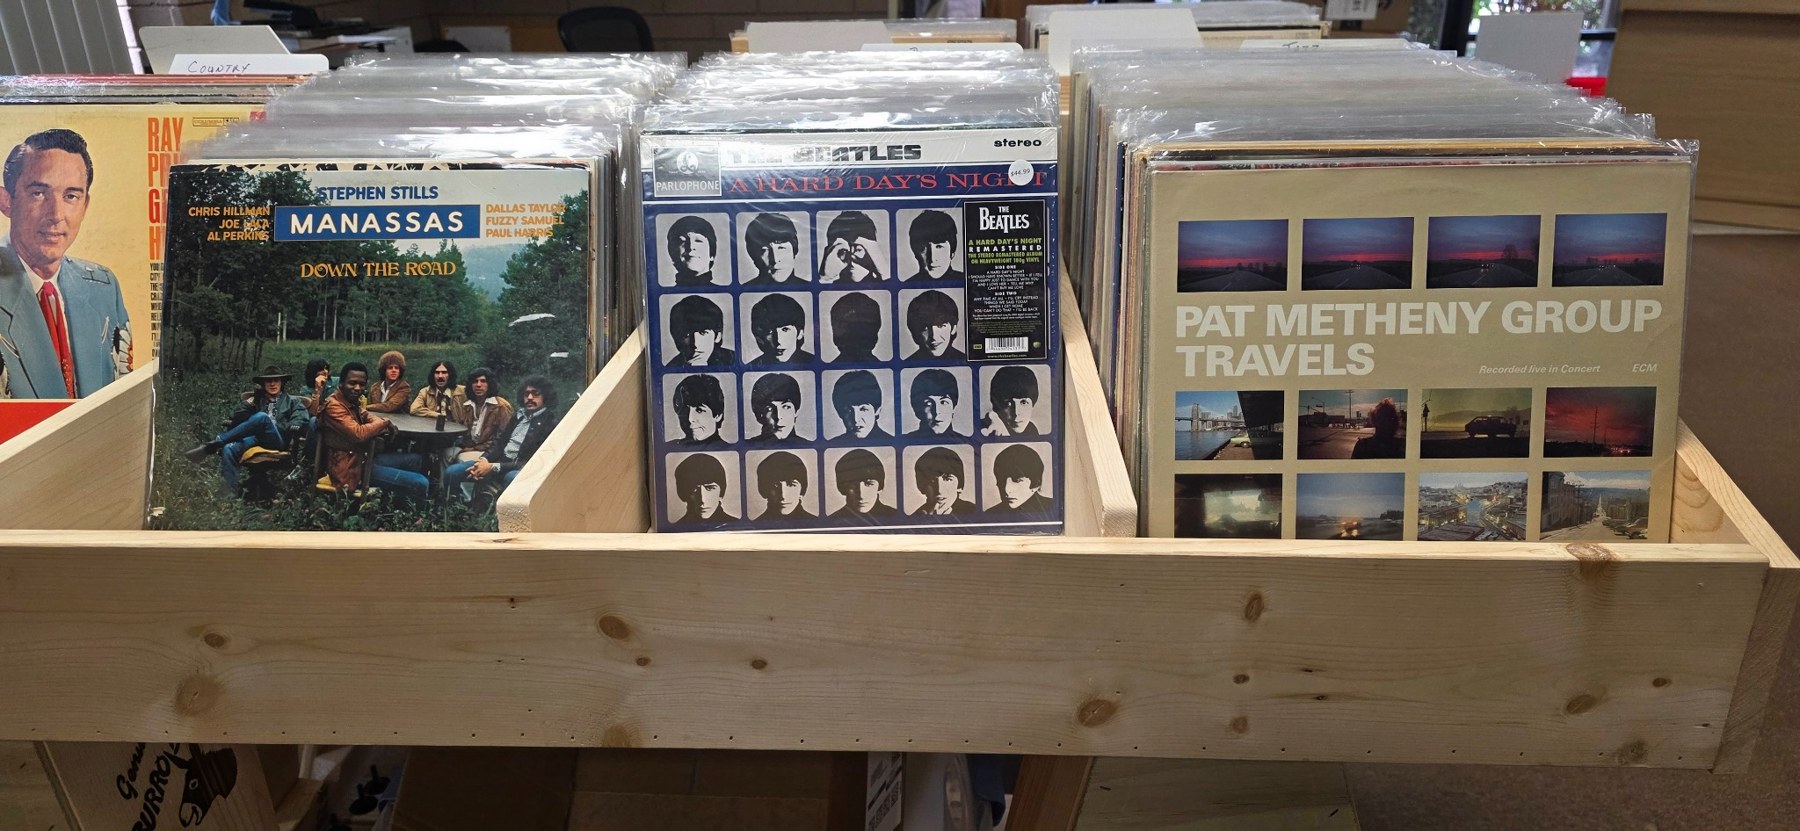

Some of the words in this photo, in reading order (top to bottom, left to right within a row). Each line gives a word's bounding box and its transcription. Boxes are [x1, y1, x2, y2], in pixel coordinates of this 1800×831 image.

[188, 61, 250, 73] COUNTRY
[148, 117, 184, 152] RAY
[994, 138, 1042, 148] stereo
[1010, 168, 1031, 176] $44.99
[656, 180, 720, 192] PARLOPHONE
[730, 177, 750, 192] A
[757, 176, 844, 192] HARD
[854, 174, 936, 190] DAY'S
[946, 171, 1047, 188] NIGT
[318, 187, 386, 200] STEPHEN
[391, 186, 439, 199] STILLS
[188, 206, 220, 217] CHRIS
[223, 205, 270, 216] HILLMAN
[486, 203, 526, 213] DALLAS
[528, 203, 567, 213] TAYLOR
[219, 219, 240, 229] JOE
[244, 219, 270, 229] LALA
[290, 211, 464, 235] MANASSAS
[486, 216, 519, 226] FUZZY
[521, 215, 565, 225] SAMUEL
[979, 207, 1030, 233] BEATLES
[207, 231, 221, 242] AL
[223, 230, 270, 241] PERKINS
[486, 228, 512, 238] PAUL
[514, 227, 554, 237] HARRIS
[969, 245, 1042, 253] REMASTERED
[301, 263, 358, 278] DOWN
[363, 262, 400, 277] THE
[404, 261, 457, 276] ROAD
[1176, 305, 1256, 338] PAT
[1266, 301, 1492, 336] METHENY
[1501, 299, 1663, 334] GROUP
[1176, 342, 1375, 377] TRAVELS
[1479, 365, 1527, 375] Recorded
[1527, 364, 1547, 374] live
[1548, 364, 1559, 374] in
[1560, 364, 1601, 374] Concert
[1632, 363, 1658, 373] ECM
